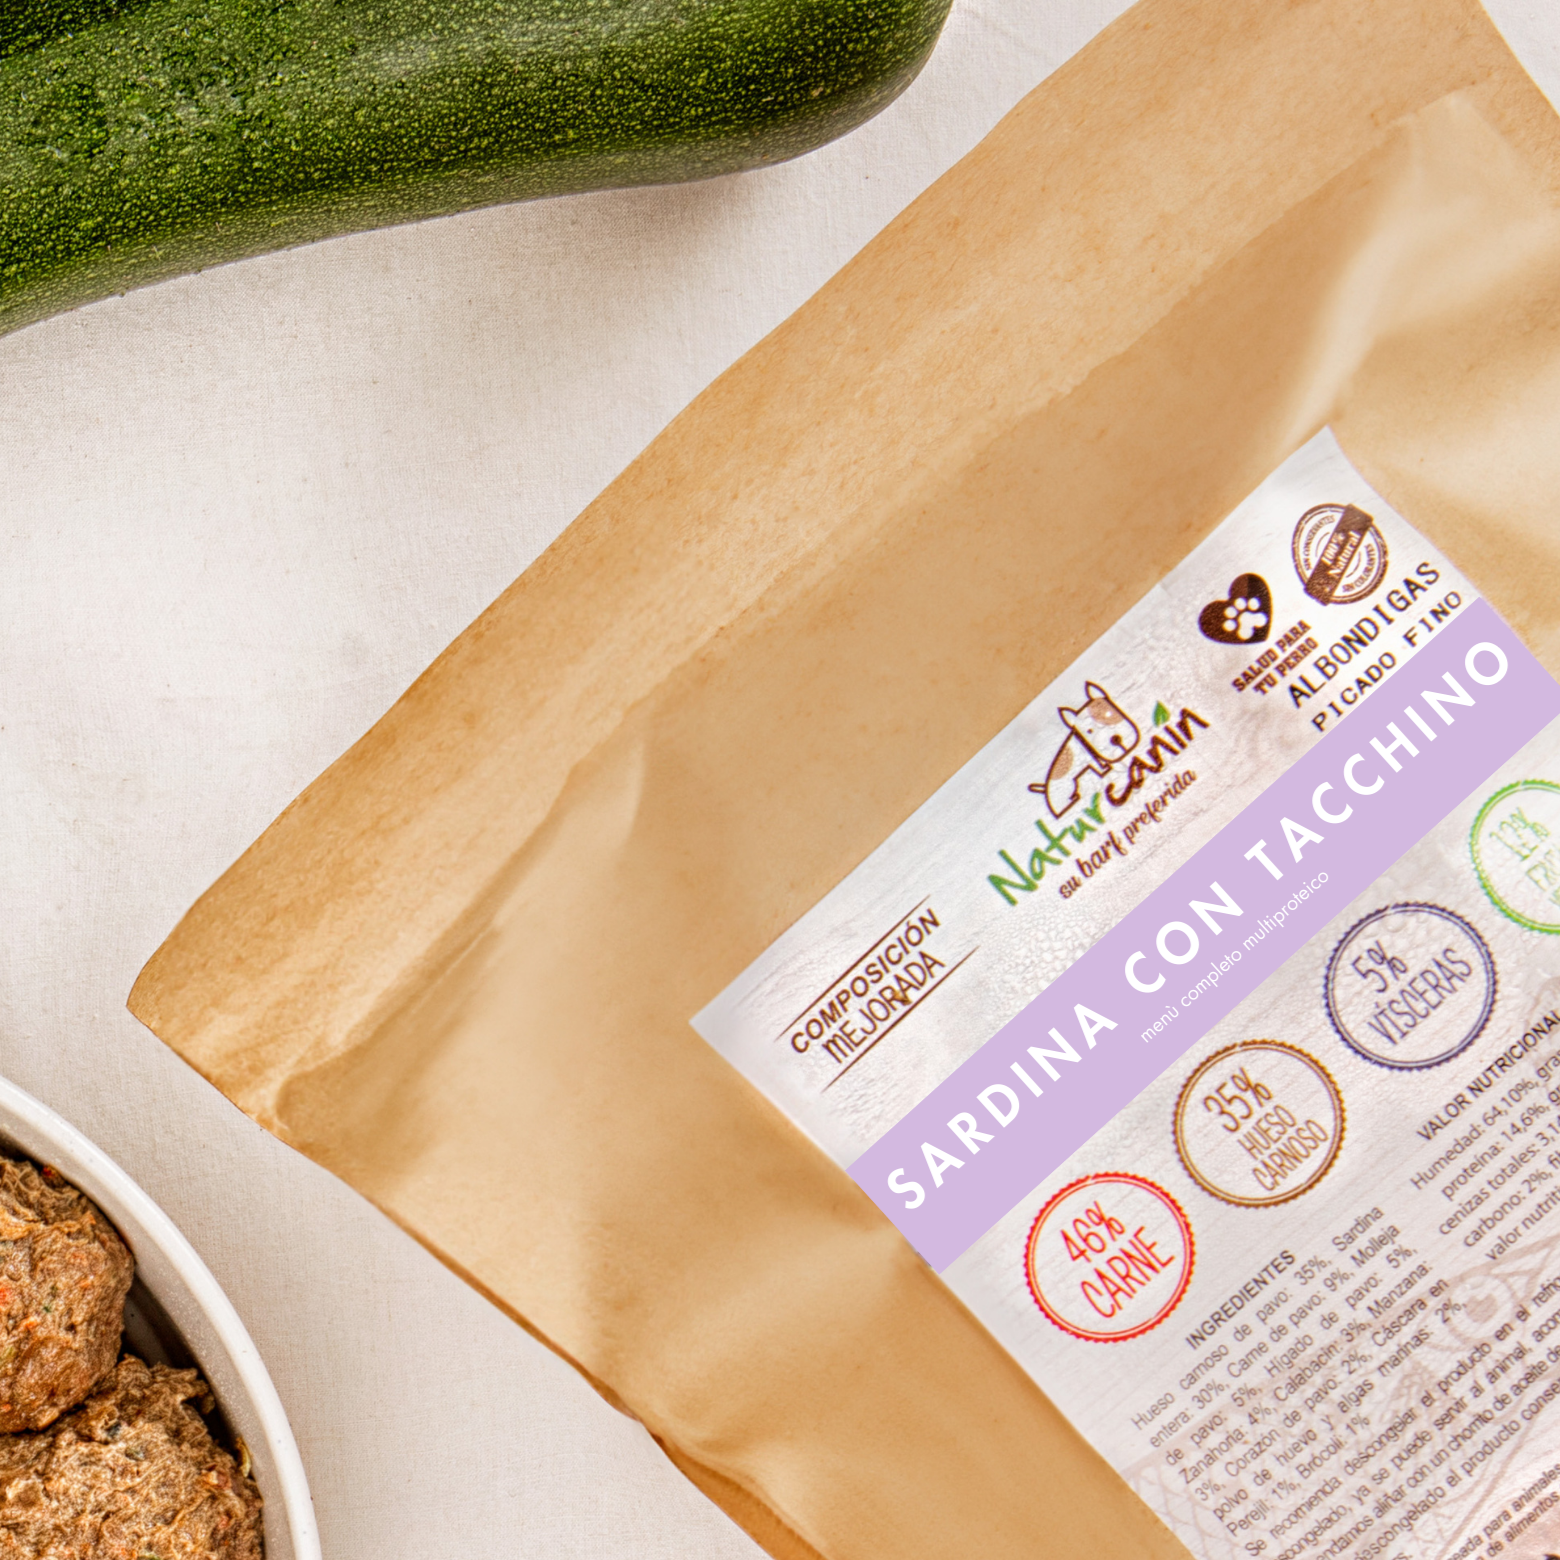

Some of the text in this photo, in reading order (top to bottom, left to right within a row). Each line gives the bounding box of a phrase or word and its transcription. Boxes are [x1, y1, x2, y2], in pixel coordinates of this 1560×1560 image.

[1319, 531, 1347, 566] 100%
[1326, 529, 1362, 579] Natural
[1230, 619, 1313, 693] SALUD PARA
[1252, 636, 1320, 696] TU PERRO
[1287, 560, 1442, 710] ALBONDIGAS
[1310, 590, 1463, 734] PICADO FINO
[1058, 768, 1198, 900] su barf preferida
[886, 641, 1509, 1210] SARDINA CON TACCHINO
[1140, 871, 1330, 1044] menù completo multiproteico
[1349, 939, 1410, 994] 5%
[789, 907, 942, 1055] COMPOSICIÓN
[1366, 946, 1474, 1046] VÍSCERAS
[1201, 1065, 1275, 1134] 35%
[1236, 1103, 1298, 1161] HUESO
[1415, 1092, 1473, 1142] VALOR
[1251, 1112, 1335, 1198] CARNOSO
[1059, 1199, 1127, 1264] 46%
[1438, 1187, 1491, 1236] cenizas
[1484, 1225, 1523, 1261] valor
[1079, 1224, 1177, 1320] CARNE
[1130, 1391, 1176, 1431] Hueso
[1179, 1343, 1230, 1391] carnoso
[1232, 1323, 1253, 1343] de
[1331, 1206, 1385, 1253] Sardina
[1184, 1248, 1297, 1351] INGREDIENTES
[1226, 1341, 1270, 1379] Carne
[1268, 1323, 1290, 1343] de
[1349, 1224, 1402, 1269] Molleja
[1165, 1447, 1185, 1467] de
[1319, 1310, 1340, 1331] de
[1282, 1409, 1303, 1429] de
[1428, 1278, 1450, 1298] en
[1212, 1488, 1249, 1523] polvo
[1252, 1468, 1273, 1487] de
[1273, 1428, 1318, 1467] huevo
[1319, 1414, 1336, 1432] y
[1336, 1378, 1375, 1415] algas
[1243, 1538, 1268, 1558] Se
[1268, 1476, 1343, 1540] recomienda
[1343, 1406, 1419, 1477] descongelar
[1419, 1389, 1437, 1409] el
[1436, 1341, 1493, 1397] producto
[1493, 1322, 1516, 1342] en
[1514, 1303, 1532, 1323] el
[1345, 1415, 1371, 1436] 1%
[1350, 1484, 1372, 1507] ya
[1370, 1467, 1391, 1486] se
[1389, 1429, 1434, 1472] puede
[1432, 1395, 1469, 1432] servir
[1468, 1379, 1486, 1399] al
[1405, 1464, 1433, 1489] con
[1429, 1448, 1451, 1468] un
[1492, 1393, 1512, 1412] de
[1509, 1360, 1549, 1397] aceite
[1445, 1468, 1463, 1489] el
[1460, 1419, 1521, 1478] producto
[1482, 1509, 1513, 1539] para
[1486, 1540, 1505, 1558] de
[1504, 1491, 1560, 1543] alimentos
